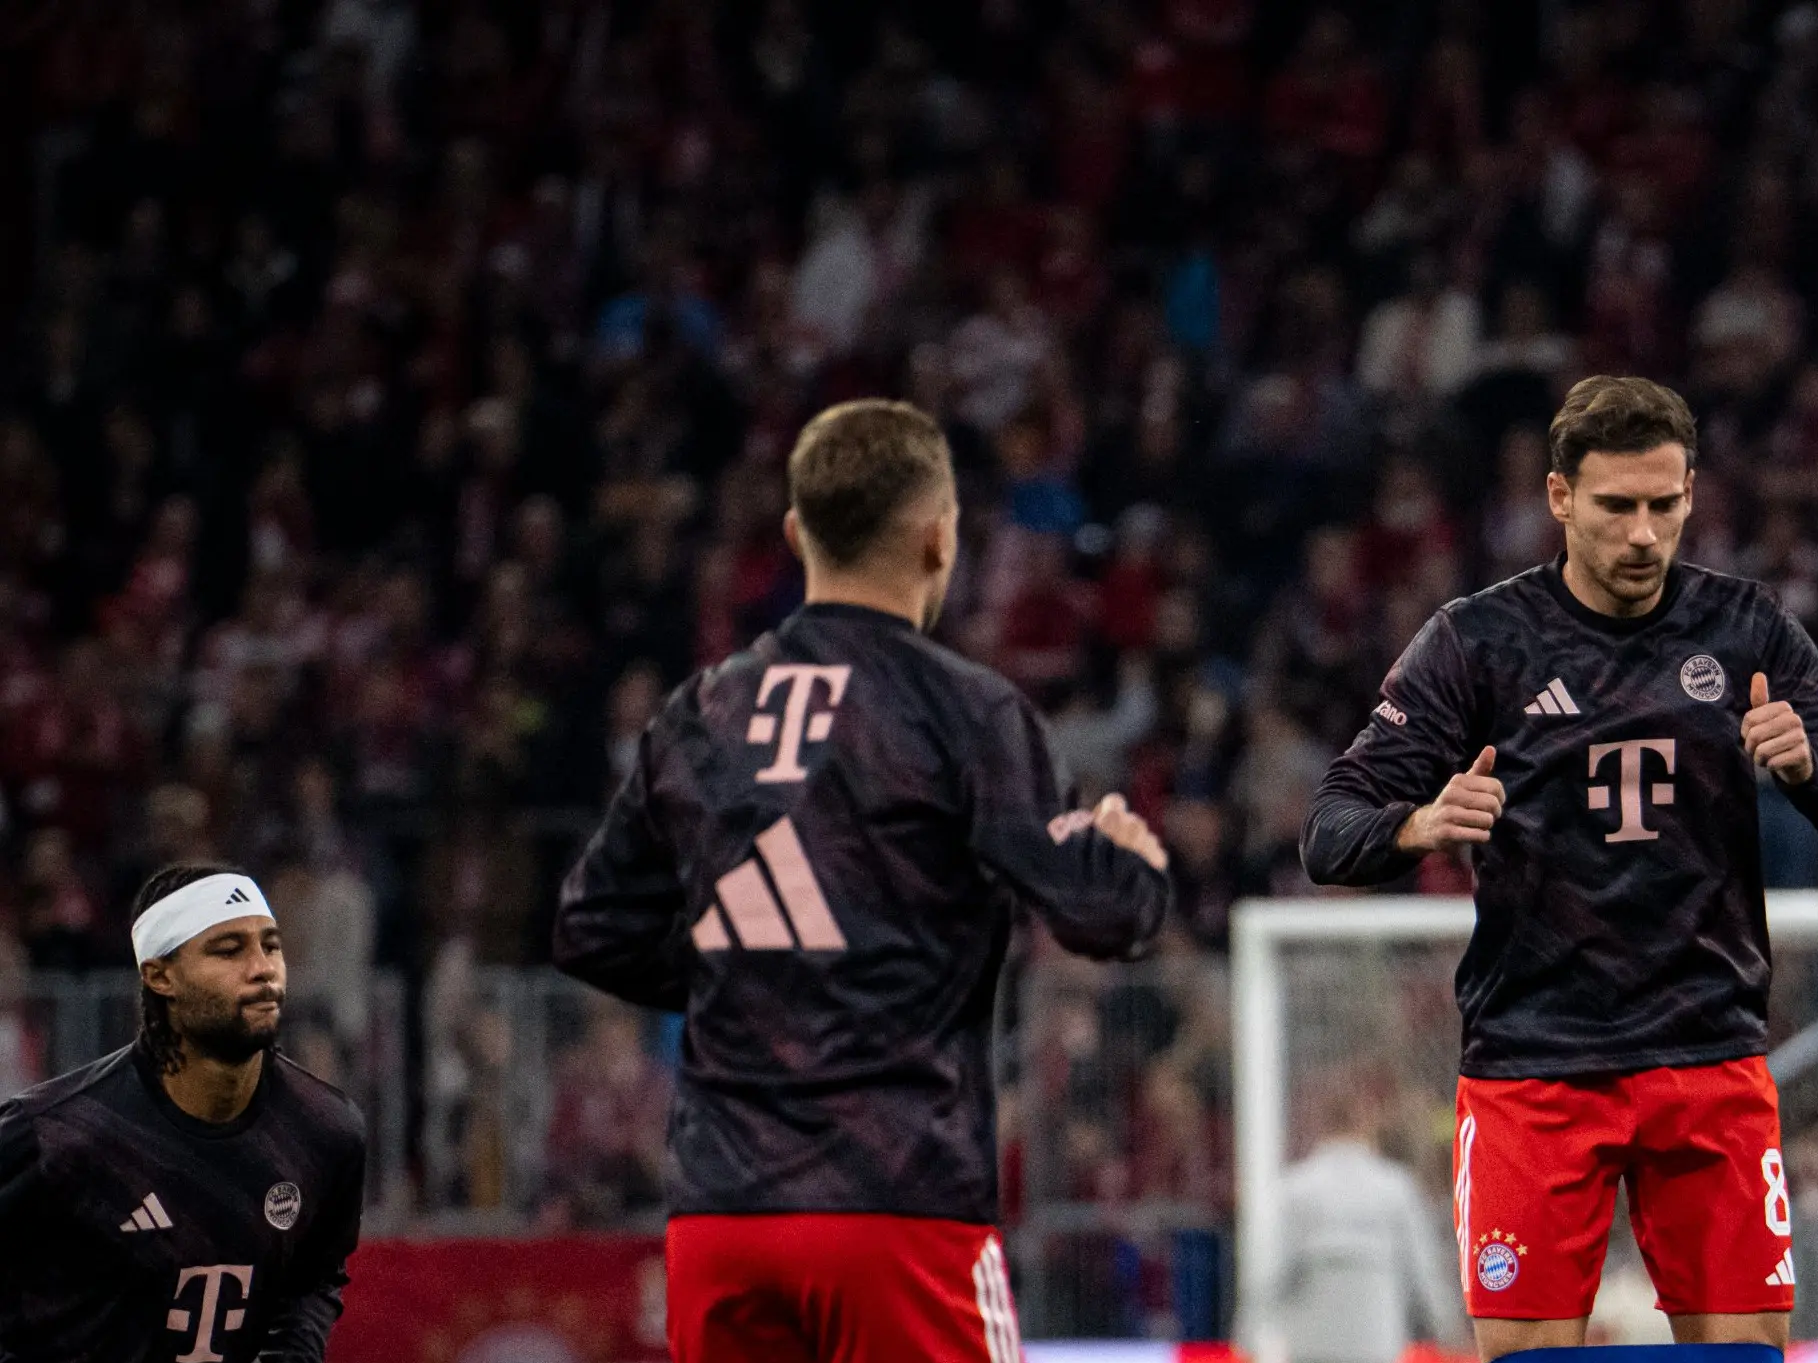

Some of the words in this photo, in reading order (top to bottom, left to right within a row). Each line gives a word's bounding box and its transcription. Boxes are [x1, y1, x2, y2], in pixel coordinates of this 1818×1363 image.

[746, 664, 852, 784] T
[1587, 738, 1675, 843] T
[1761, 1148, 1791, 1236] 8
[166, 1264, 253, 1363] T
